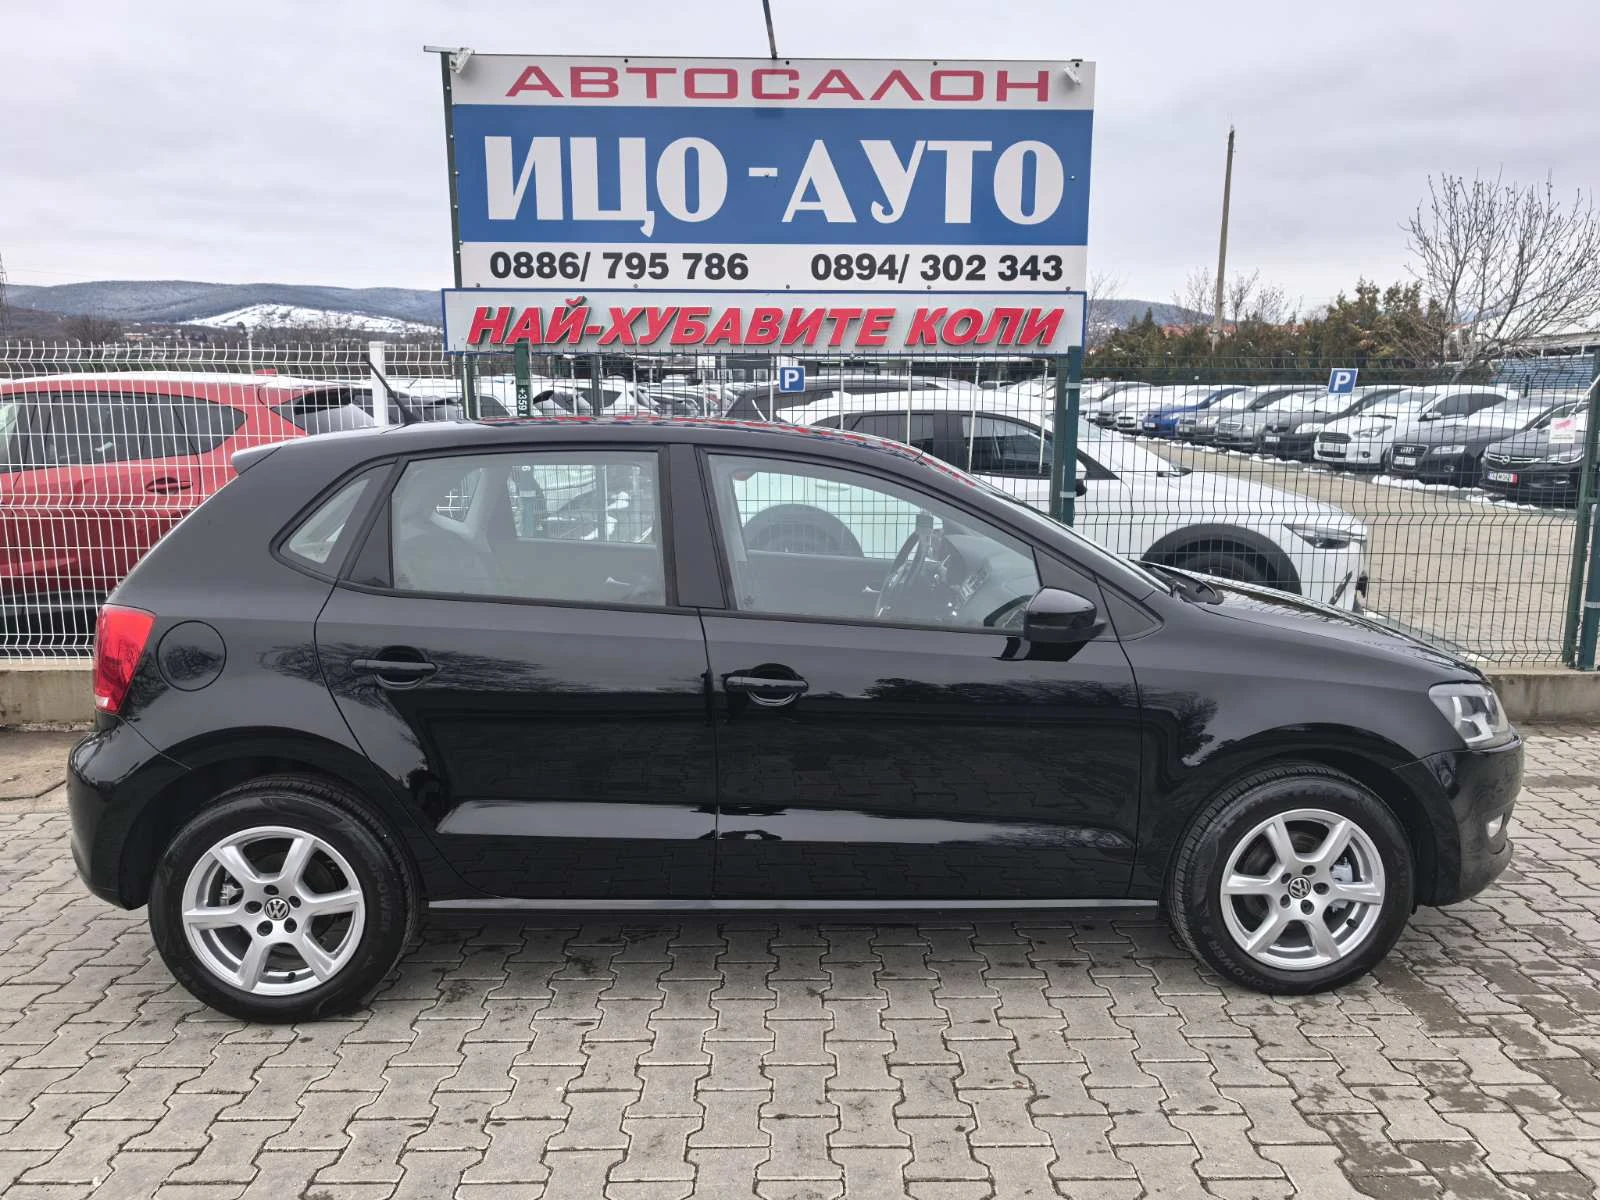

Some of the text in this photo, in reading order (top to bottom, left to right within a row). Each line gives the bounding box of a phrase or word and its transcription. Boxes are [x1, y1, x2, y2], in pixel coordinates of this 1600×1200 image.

[505, 66, 1049, 102] АВТОСАЛОН
[484, 136, 728, 238] ИЦО
[489, 251, 749, 282] 0886/ 795 786
[810, 253, 1063, 284] 0894/ 302 343
[465, 296, 1065, 346] НАЙ-ХУБАВИТЕ КОЛИ
[784, 369, 800, 389] P
[1333, 371, 1351, 391] P
